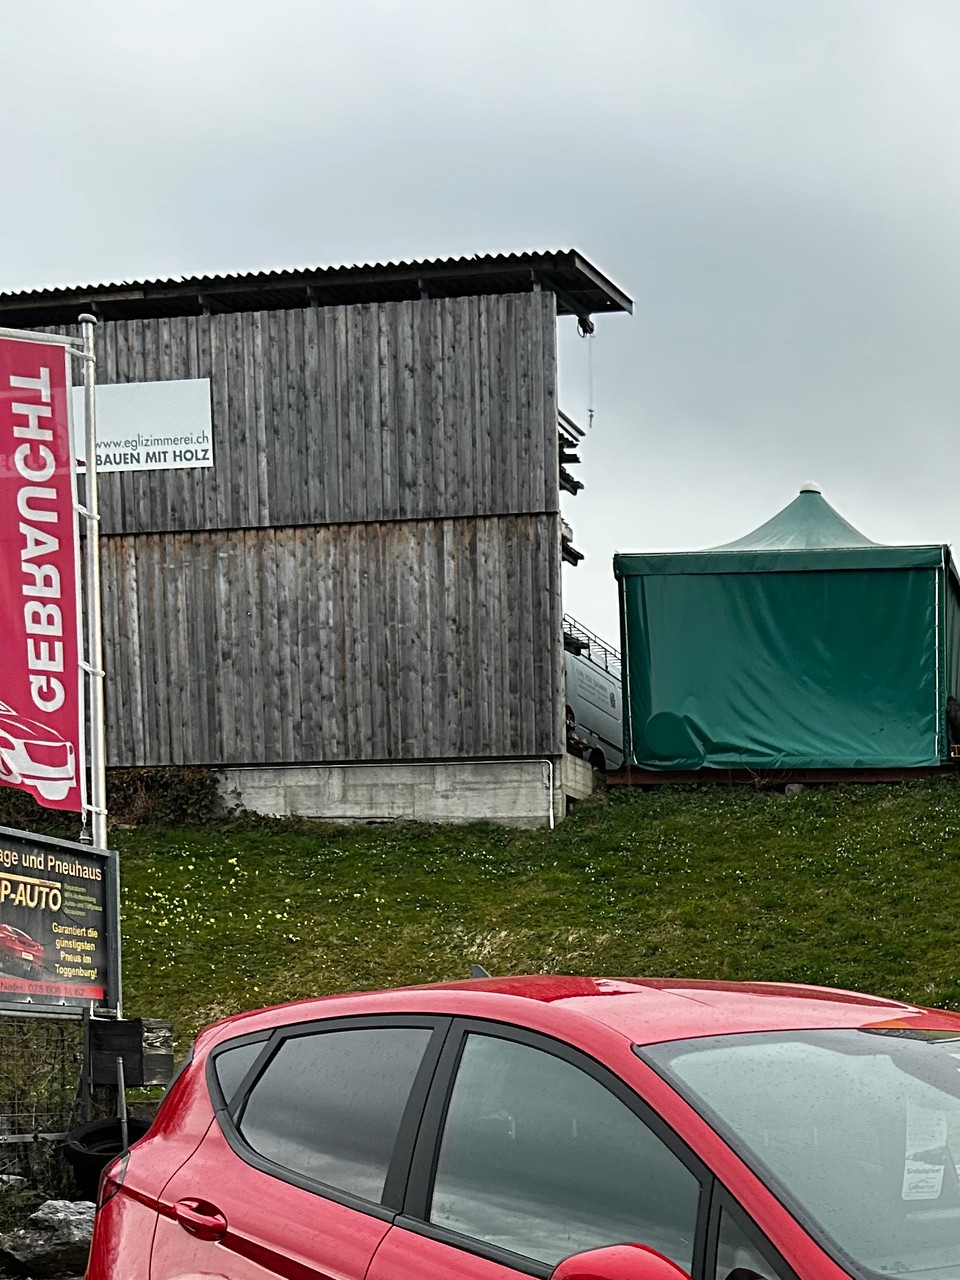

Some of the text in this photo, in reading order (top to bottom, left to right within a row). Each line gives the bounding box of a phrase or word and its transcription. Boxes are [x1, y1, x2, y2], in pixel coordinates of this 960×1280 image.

[96, 448, 209, 466] BAUEN MIT HOLZ
[22, 853, 44, 870] und
[47, 855, 102, 881] Pneuhaus
[52, 922, 98, 938] Garantiert die
[55, 937, 96, 952] günstigsten
[60, 950, 92, 964] Pneus im
[54, 963, 98, 980] Toggenburg!
